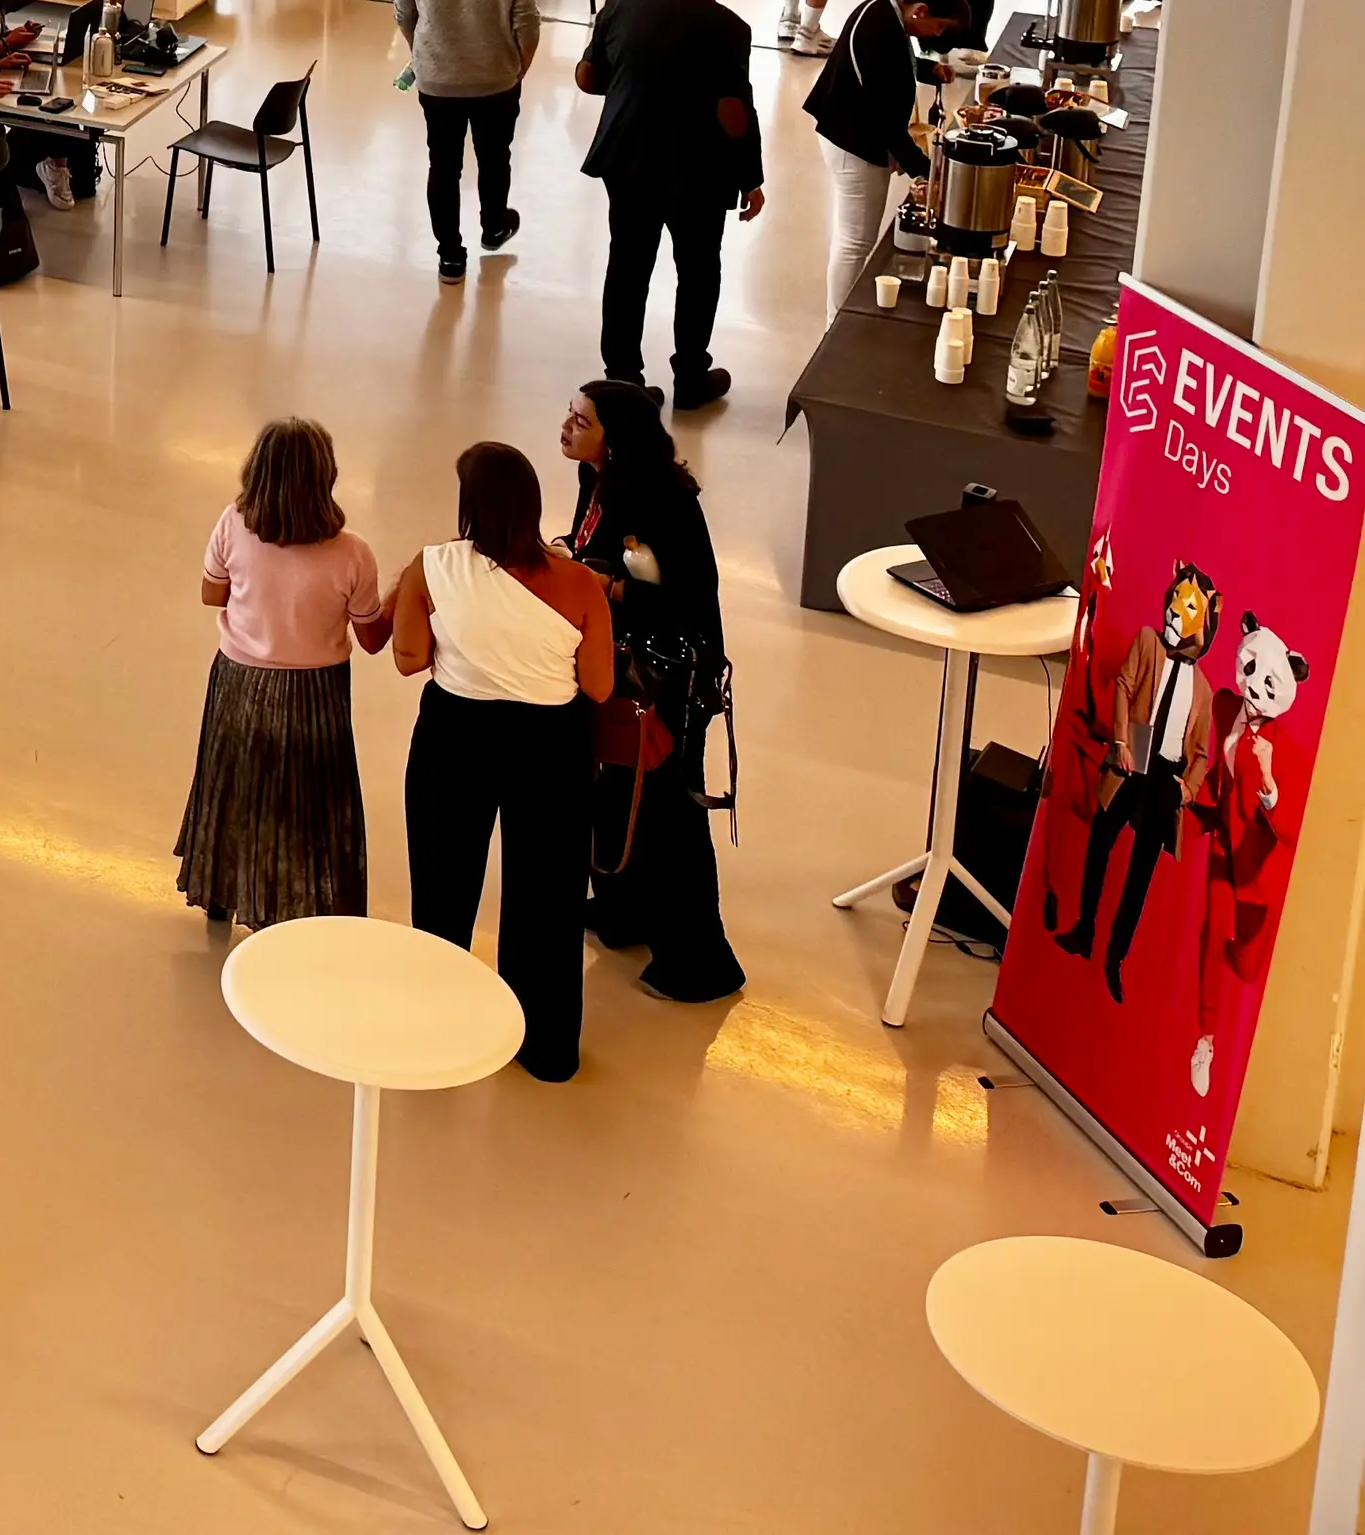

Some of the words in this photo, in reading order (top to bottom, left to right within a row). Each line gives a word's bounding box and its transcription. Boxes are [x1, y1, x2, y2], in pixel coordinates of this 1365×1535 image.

[1173, 347, 1353, 502] EVENTS
[1165, 419, 1232, 495] Days
[1165, 1133, 1192, 1168] Meet
[1168, 1154, 1201, 1193] &Com
